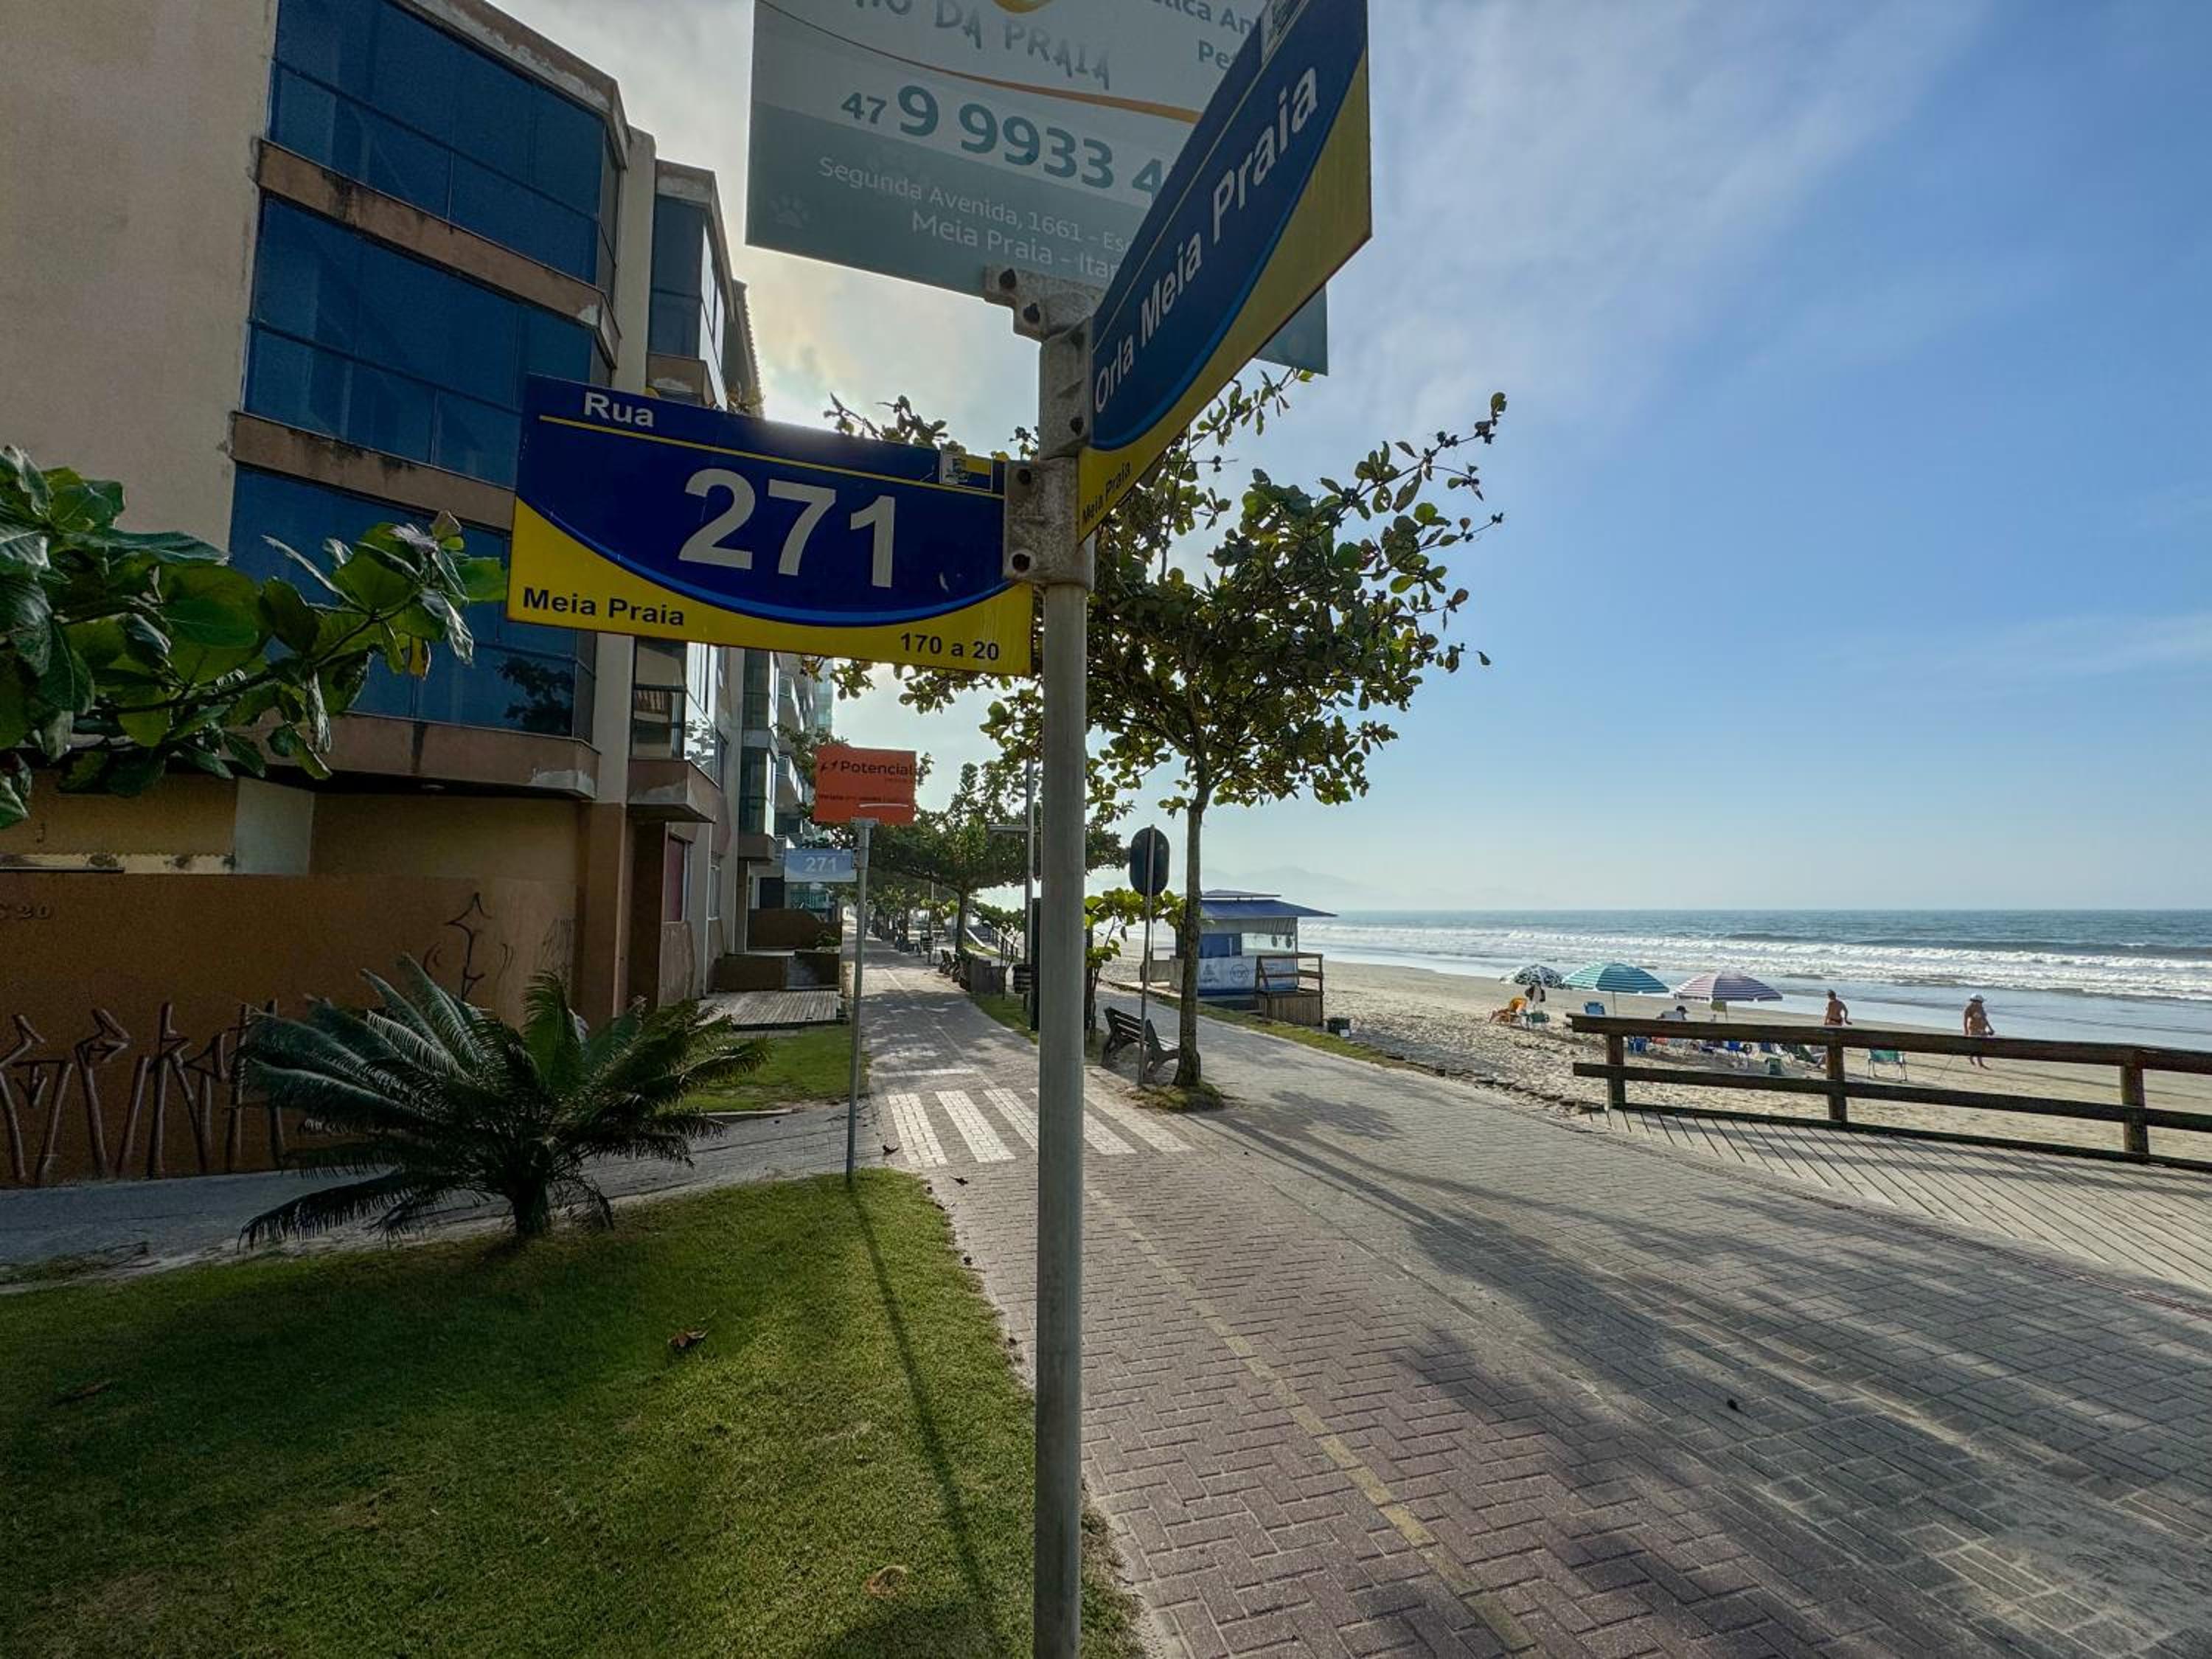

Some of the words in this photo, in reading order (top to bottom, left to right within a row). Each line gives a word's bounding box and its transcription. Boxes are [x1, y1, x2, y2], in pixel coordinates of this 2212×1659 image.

[935, 0, 981, 49] DA
[1005, 21, 1110, 90] PRAIA
[841, 91, 887, 124] 47
[897, 85, 939, 137] 9
[959, 103, 1114, 189] 9933
[818, 156, 922, 200] Segunda
[929, 187, 1023, 230] Avenida,
[1028, 212, 1082, 242] 1661
[912, 210, 979, 247] Meia
[987, 229, 1053, 265] Praia
[1095, 334, 1134, 414] Orla
[1140, 231, 1203, 349] Meia
[1213, 66, 1318, 245] Praia
[584, 392, 654, 428] Rua
[678, 467, 896, 588] 271
[523, 587, 597, 616] Meia
[609, 598, 685, 627] Praia
[901, 633, 942, 654] 170
[950, 642, 964, 657] a
[972, 641, 1000, 661] 20
[840, 760, 914, 776] Potencial
[804, 856, 837, 873] 271
